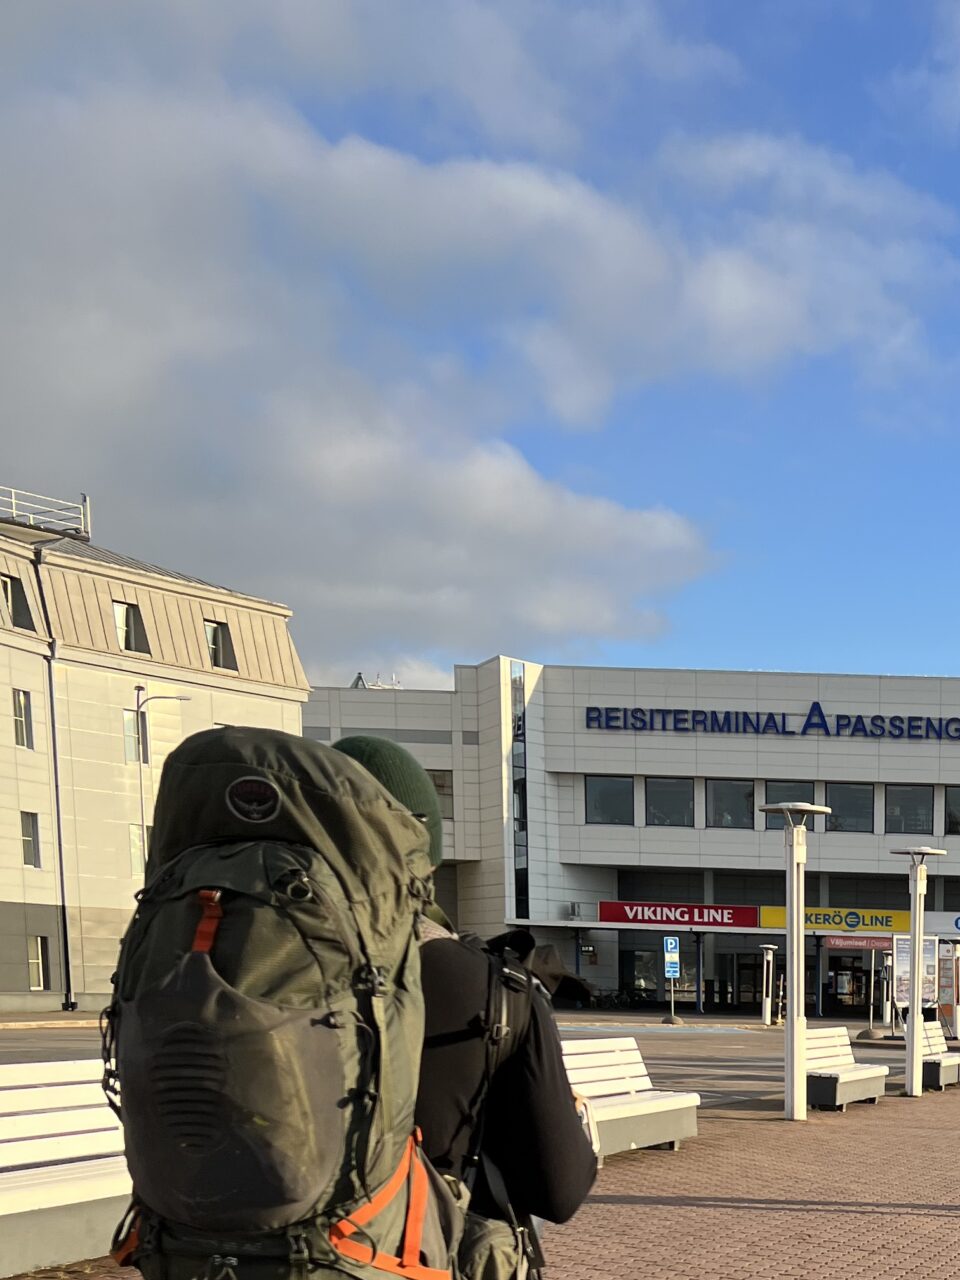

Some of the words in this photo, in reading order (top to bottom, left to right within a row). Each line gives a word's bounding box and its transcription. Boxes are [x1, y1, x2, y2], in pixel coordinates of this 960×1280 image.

[585, 706, 796, 735] REISITERMINAL
[801, 701, 831, 736] A
[624, 905, 689, 921] VIKING
[693, 908, 734, 923] LINE
[804, 910, 843, 927] KERÖ
[861, 915, 893, 927] LINE
[667, 939, 676, 952] P
